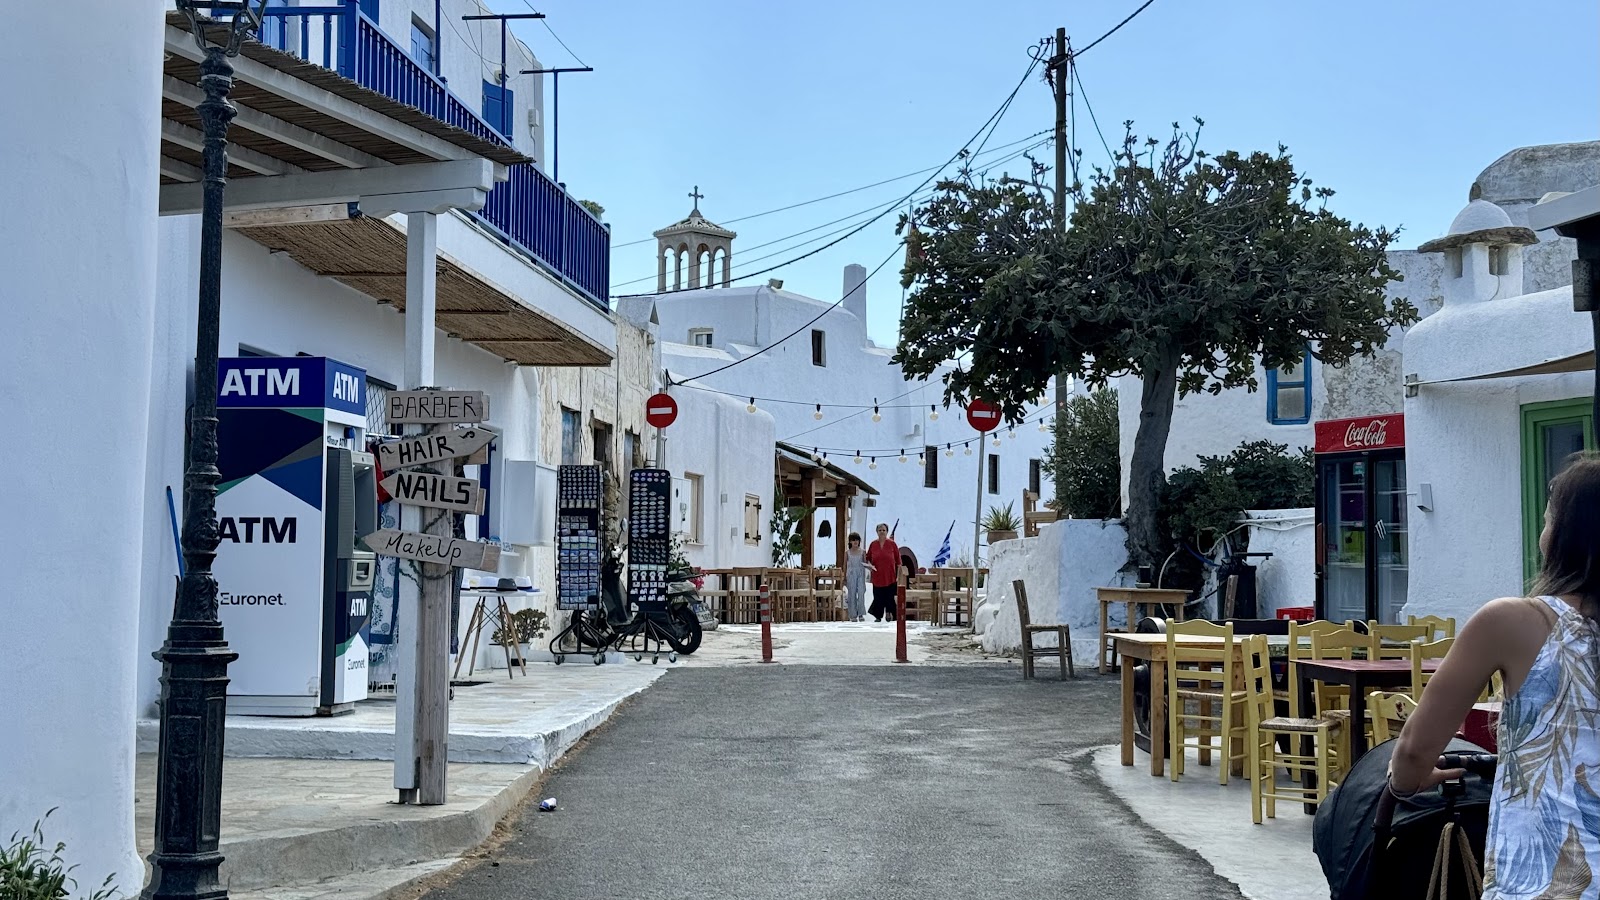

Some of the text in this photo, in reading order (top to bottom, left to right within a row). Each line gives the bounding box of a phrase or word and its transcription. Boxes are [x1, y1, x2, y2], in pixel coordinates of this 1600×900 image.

[220, 368, 300, 396] ATM
[333, 371, 359, 404] ATM
[391, 396, 476, 418] BARBER
[1344, 419, 1388, 448] Coca-Cola
[399, 436, 455, 464] HAIR
[395, 474, 471, 504] NAILS
[219, 517, 297, 543] ATM
[385, 533, 462, 566] MakeUp
[350, 598, 367, 617] ATM
